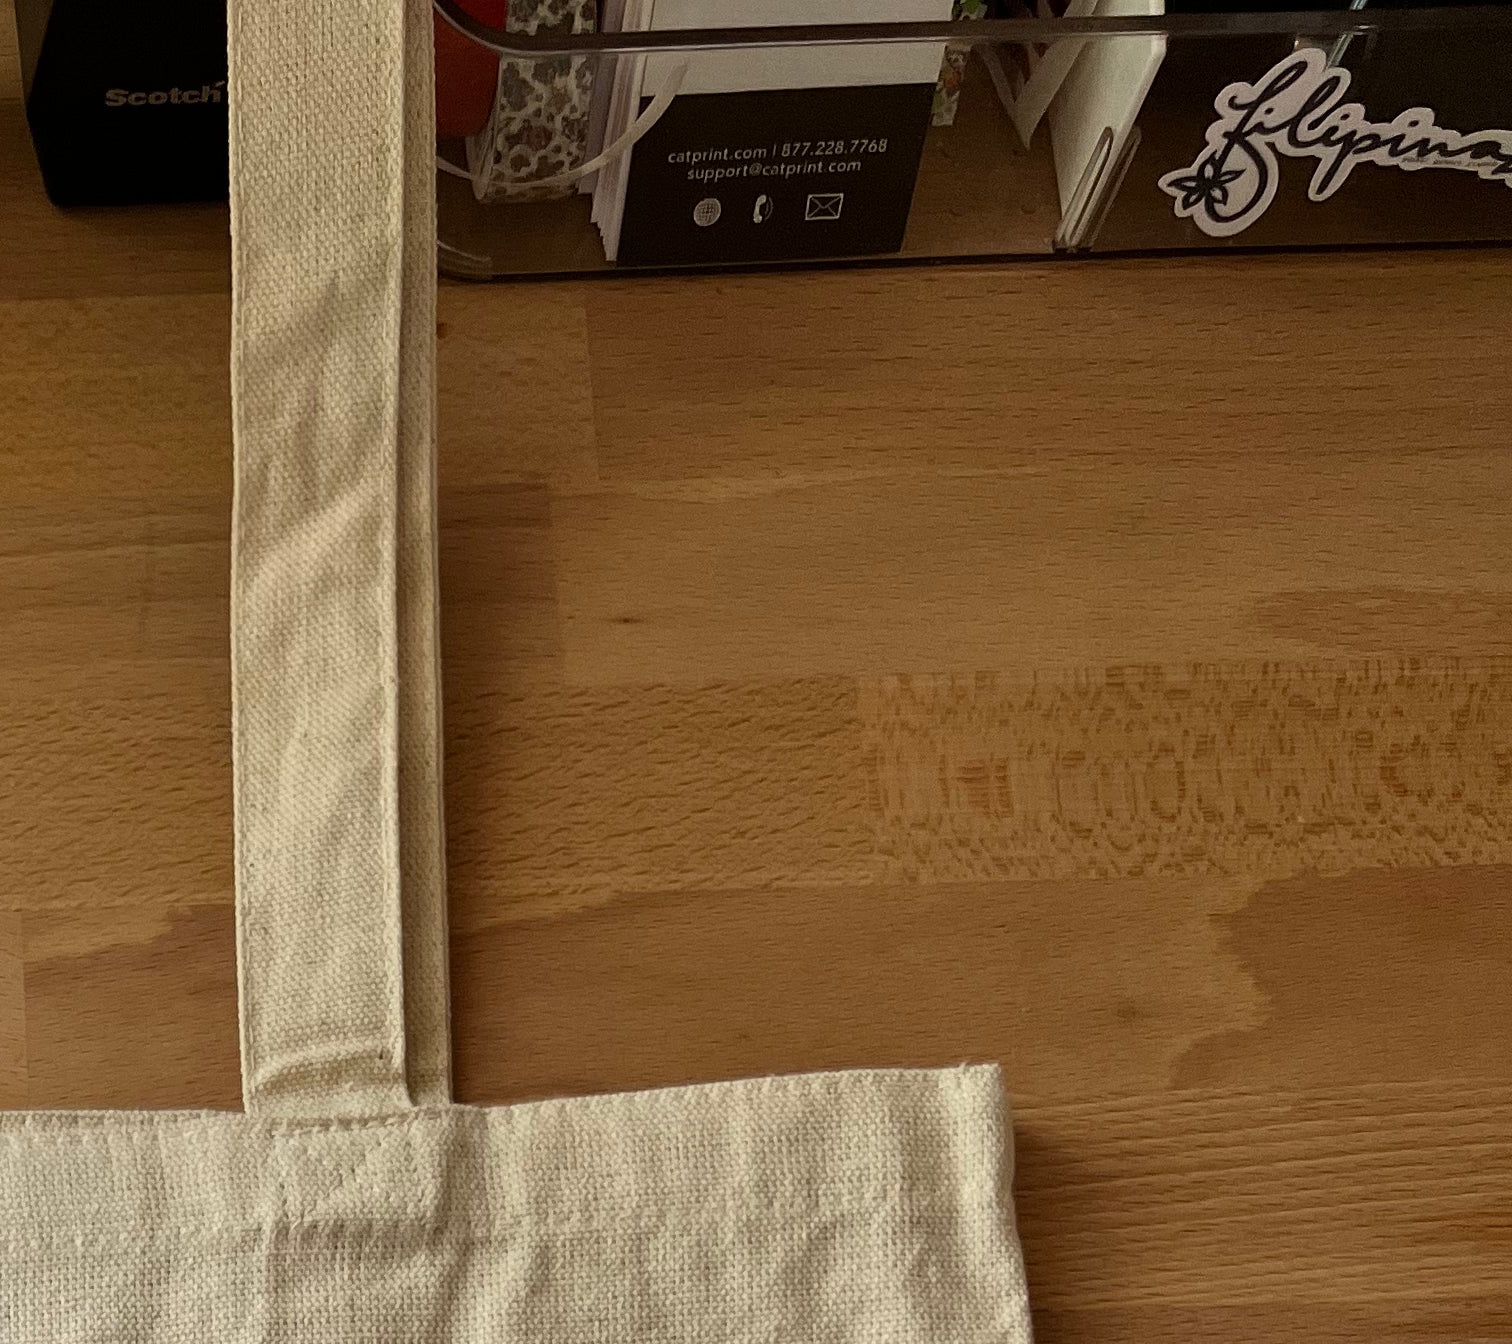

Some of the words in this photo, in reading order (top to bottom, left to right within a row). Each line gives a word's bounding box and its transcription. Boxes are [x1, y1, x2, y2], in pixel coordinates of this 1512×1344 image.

[104, 82, 225, 107] Scotch
[667, 147, 767, 166] catprint.com
[781, 137, 889, 158] 877.228.7768
